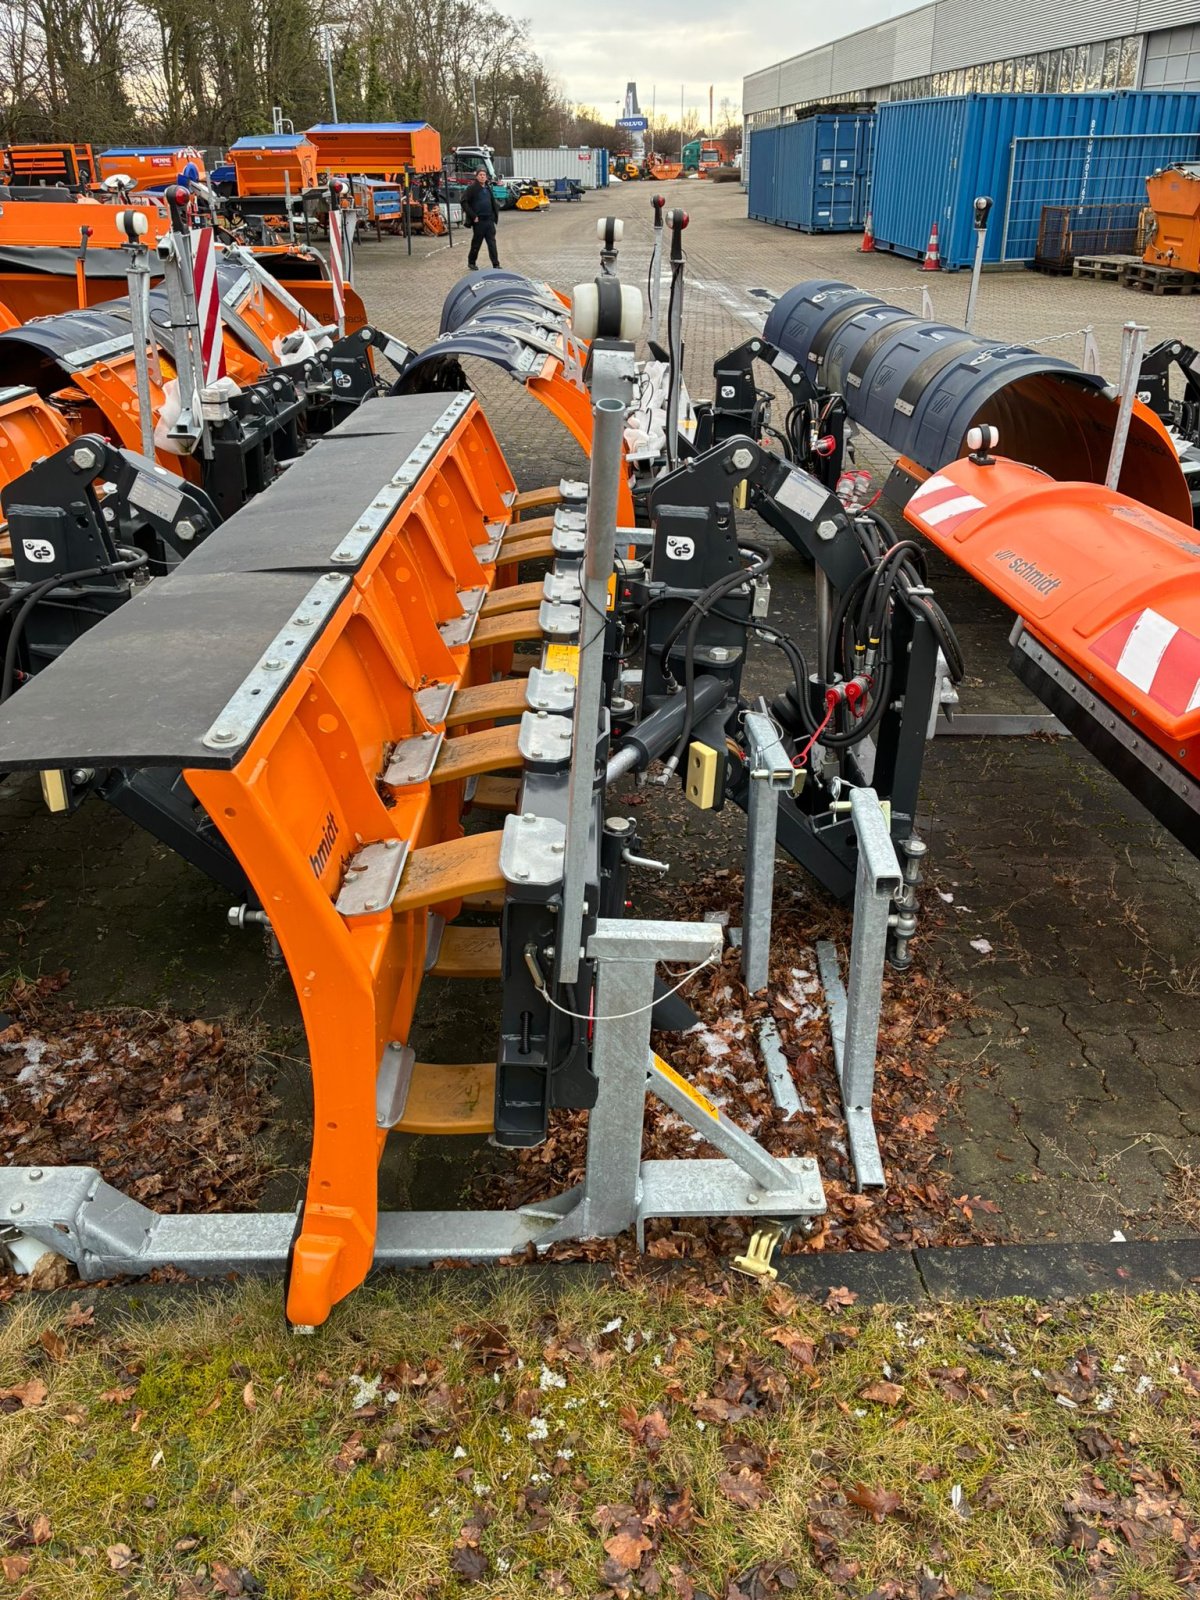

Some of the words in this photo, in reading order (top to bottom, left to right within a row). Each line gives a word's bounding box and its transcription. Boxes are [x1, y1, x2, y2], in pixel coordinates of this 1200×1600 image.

[33, 545, 51, 560] GS
[674, 543, 691, 557] GS
[1008, 557, 1062, 596] schmidt
[308, 810, 339, 880] hmidt
